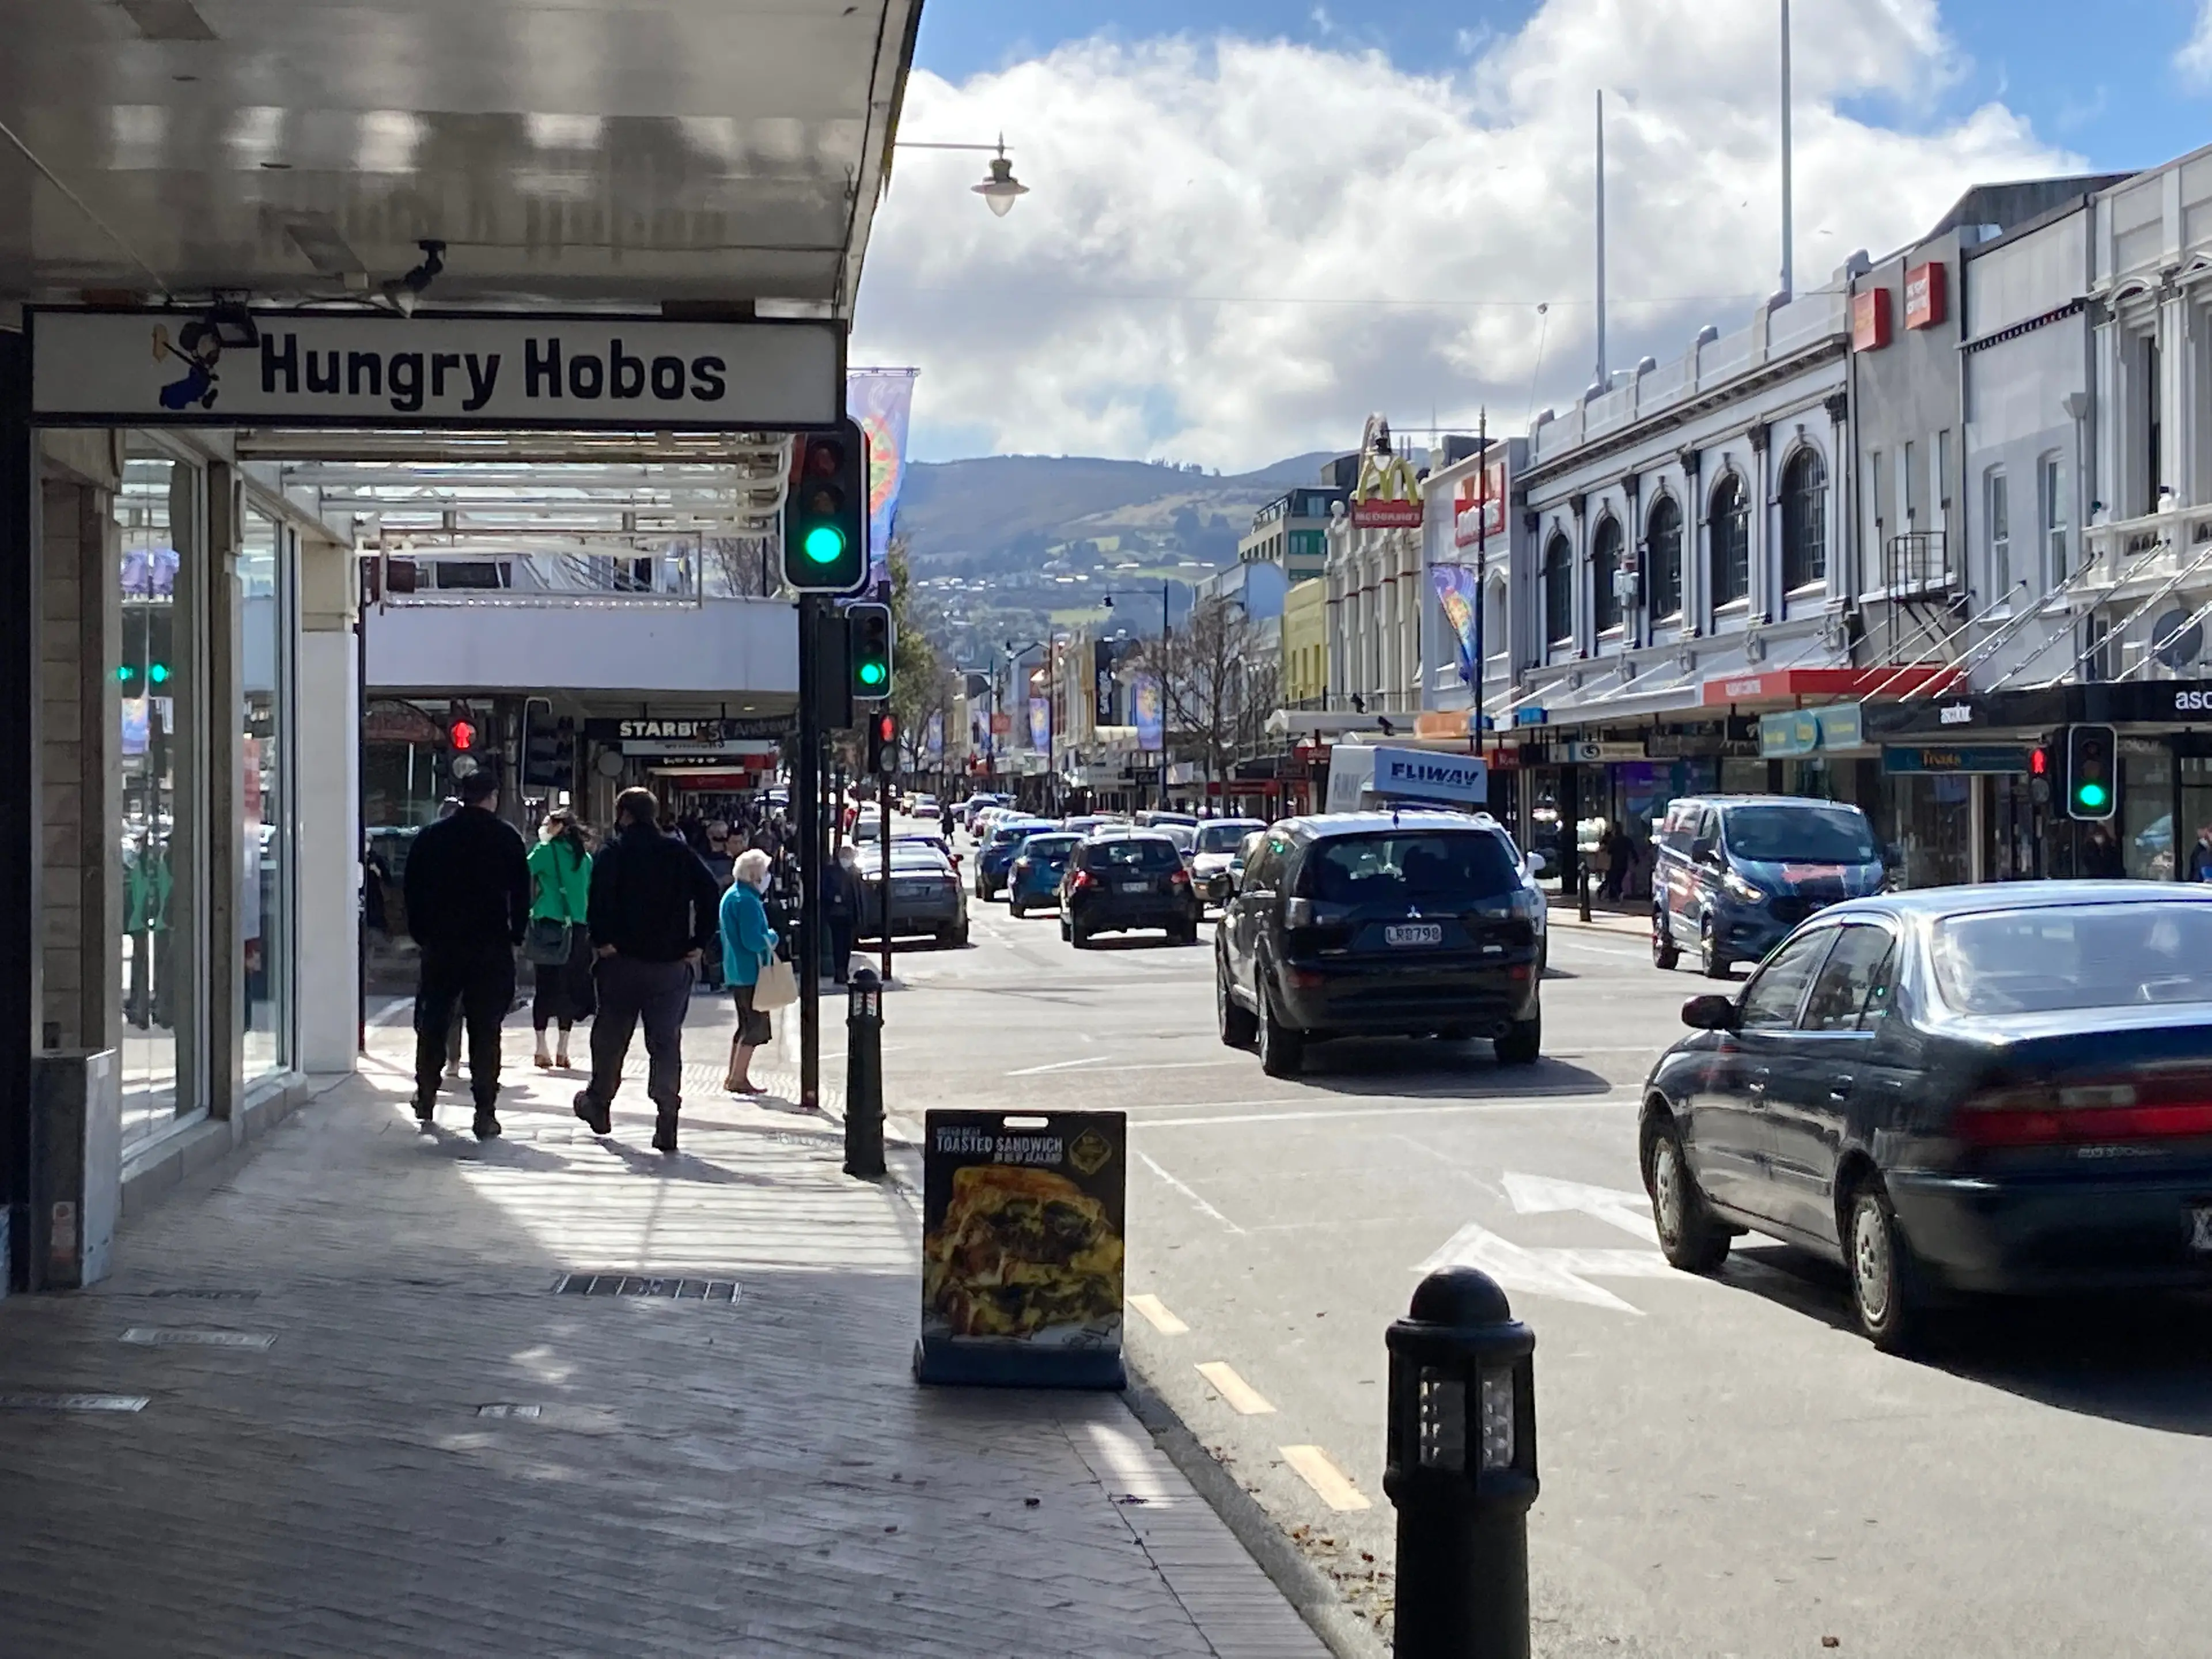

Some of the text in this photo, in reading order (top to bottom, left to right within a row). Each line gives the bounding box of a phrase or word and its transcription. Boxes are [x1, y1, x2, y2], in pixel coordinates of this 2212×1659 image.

[261, 333, 726, 412] Hungry Hobos
[620, 721, 709, 737] STARB
[935, 1135, 993, 1153] TOASTED
[995, 1136, 1063, 1153] SANDWICH
